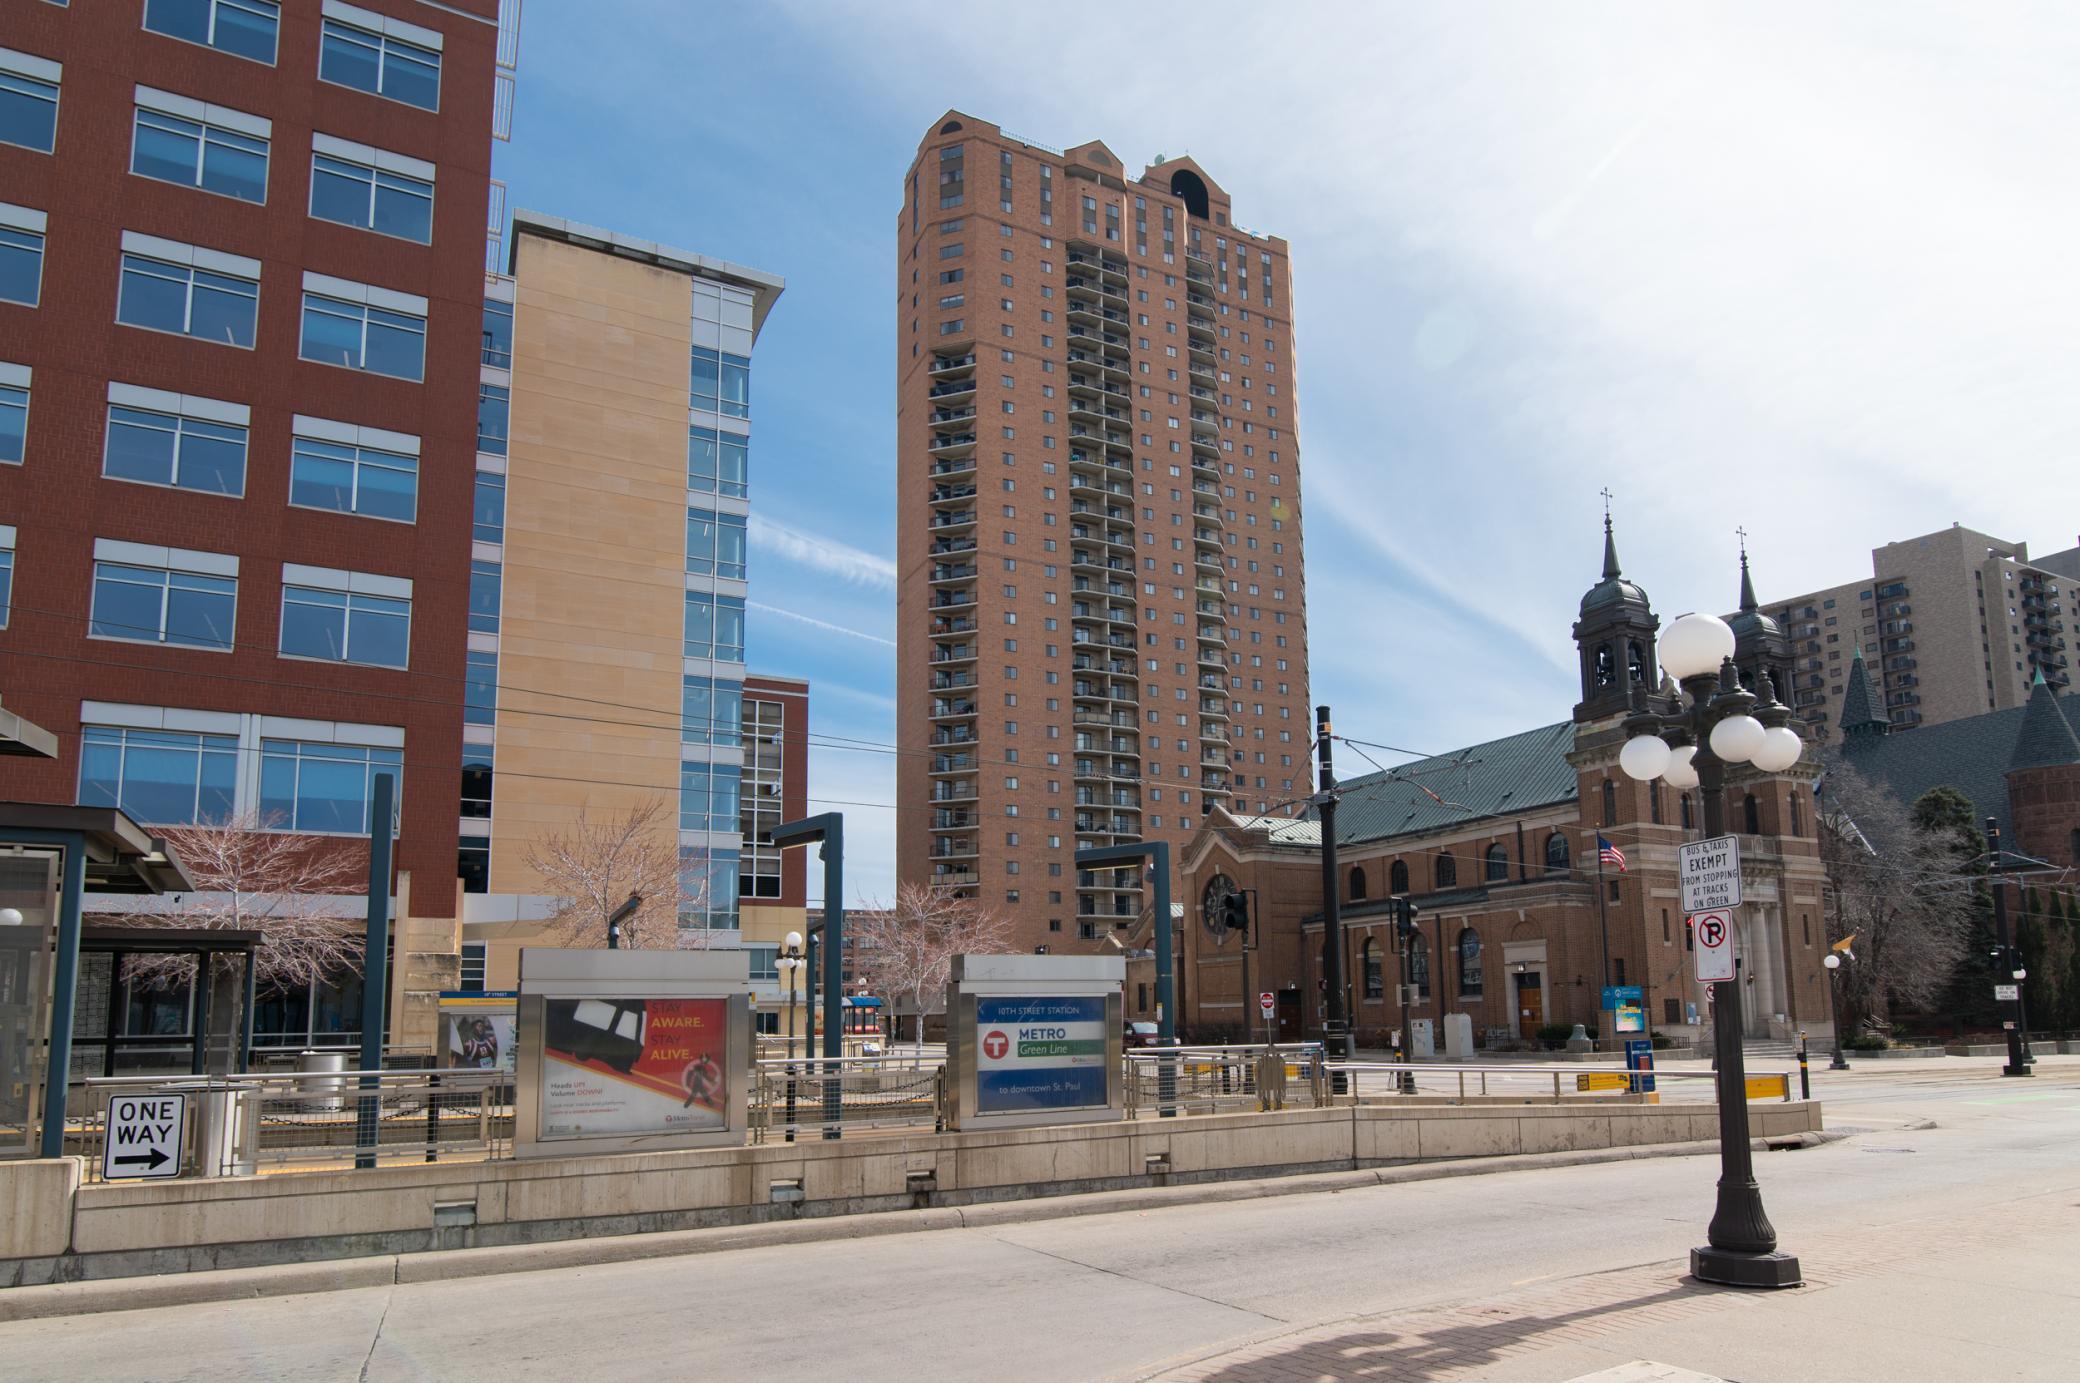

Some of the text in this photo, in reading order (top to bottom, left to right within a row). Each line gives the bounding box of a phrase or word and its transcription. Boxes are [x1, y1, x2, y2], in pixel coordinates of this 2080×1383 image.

[1686, 840, 1729, 855] BUS & TAXIS
[1690, 853, 1727, 872] EXEMPT
[1682, 869, 1738, 886] FROM STOPPING
[1693, 883, 1729, 897] AT TRACKS
[1694, 896, 1729, 908] ON GREEN
[1708, 922, 1721, 943] P
[652, 1001, 682, 1014] STAY
[998, 1006, 1080, 1015] 10TH STREET STATION
[652, 1016, 705, 1028] AWARE.
[651, 1033, 681, 1045] STAY
[1019, 1028, 1066, 1040] METRO
[650, 1048, 694, 1060] ALIVE.
[1020, 1044, 1068, 1055] Green Line
[1011, 1085, 1051, 1094] downtown
[1053, 1082, 1062, 1091] St.
[1065, 1082, 1081, 1091] Paul
[120, 1102, 174, 1121] ONE
[117, 1124, 173, 1144] WAY
